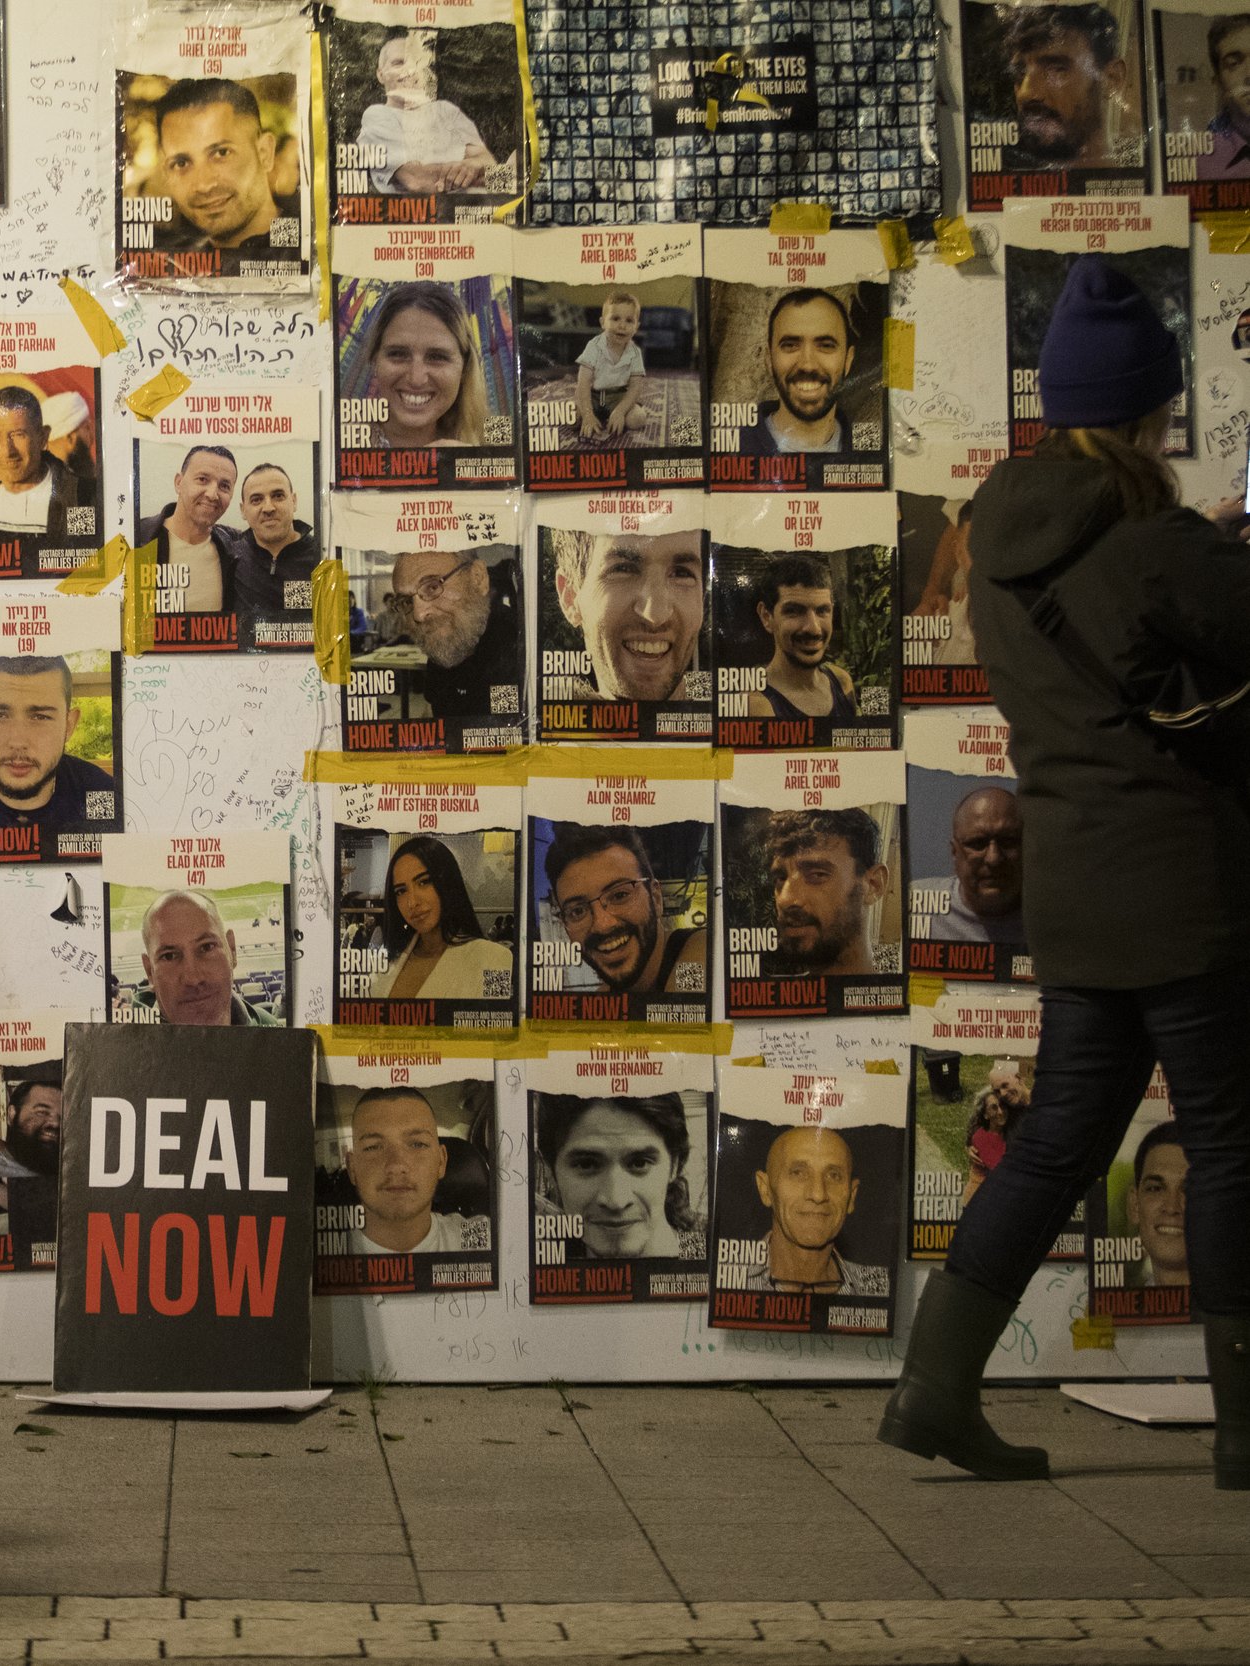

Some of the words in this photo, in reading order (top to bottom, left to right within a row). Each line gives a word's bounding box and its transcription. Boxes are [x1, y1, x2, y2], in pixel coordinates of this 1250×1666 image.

[658, 61, 691, 83] LOOK
[747, 58, 771, 78] THE
[774, 56, 806, 77] EYES
[658, 85, 675, 99] IT'S
[676, 83, 693, 98] OUR
[759, 81, 783, 95] THEM
[784, 80, 807, 94] BACK
[1041, 218, 1070, 232] HERSH
[1087, 232, 1107, 249] (23)
[374, 248, 406, 261] DORON
[406, 247, 475, 261] STEINBRECHER
[581, 248, 605, 263] ARIEL
[608, 249, 637, 263] BIBAS
[768, 253, 783, 266] TAL
[787, 253, 827, 266] SHOHAM
[415, 263, 435, 277] (30)
[788, 268, 807, 283] (38)
[14, 322, 37, 337] פרחן
[17, 339, 57, 352] FARHAN
[185, 397, 222, 413] שרעבי
[224, 396, 251, 413] ויוסי
[252, 396, 272, 413] אלי
[340, 398, 389, 424] BRING
[159, 418, 177, 435] ELI
[179, 418, 203, 434] AND
[205, 418, 239, 434] YOSSI
[241, 417, 293, 434] SHARABI
[340, 422, 372, 449] HER
[340, 451, 385, 476] HOME
[390, 448, 437, 476] NOW!
[787, 500, 802, 517] לוי
[803, 501, 820, 517] אור
[396, 518, 419, 532] ALEX
[421, 517, 458, 532] DANCYG
[784, 516, 798, 531] OR
[799, 516, 822, 532] LEVY
[418, 532, 438, 548] (75)
[794, 530, 814, 547] (33)
[1, 623, 17, 636] NIK
[19, 622, 51, 636] BEIZER
[17, 638, 36, 653] (19)
[785, 777, 810, 790] ARIEL
[813, 776, 841, 790] CUNIO
[378, 799, 400, 813] AMIT
[403, 799, 437, 813] ESTHER
[440, 798, 480, 813] BUSKILA
[587, 792, 613, 804] ALON
[613, 792, 655, 805] SHAMRIZ
[804, 793, 822, 809] (26)
[418, 815, 438, 829] (28)
[611, 807, 631, 821] (26)
[167, 853, 191, 869] ELAD
[192, 854, 226, 868] KATZIR
[186, 870, 207, 885] (47)
[20, 1038, 47, 1052] HORN
[390, 1068, 410, 1084] (22)
[576, 1063, 608, 1077] ORYON
[609, 1063, 663, 1077] HERNANDEZ
[89, 1097, 288, 1192] DEAL
[85, 1212, 287, 1317] NOW
